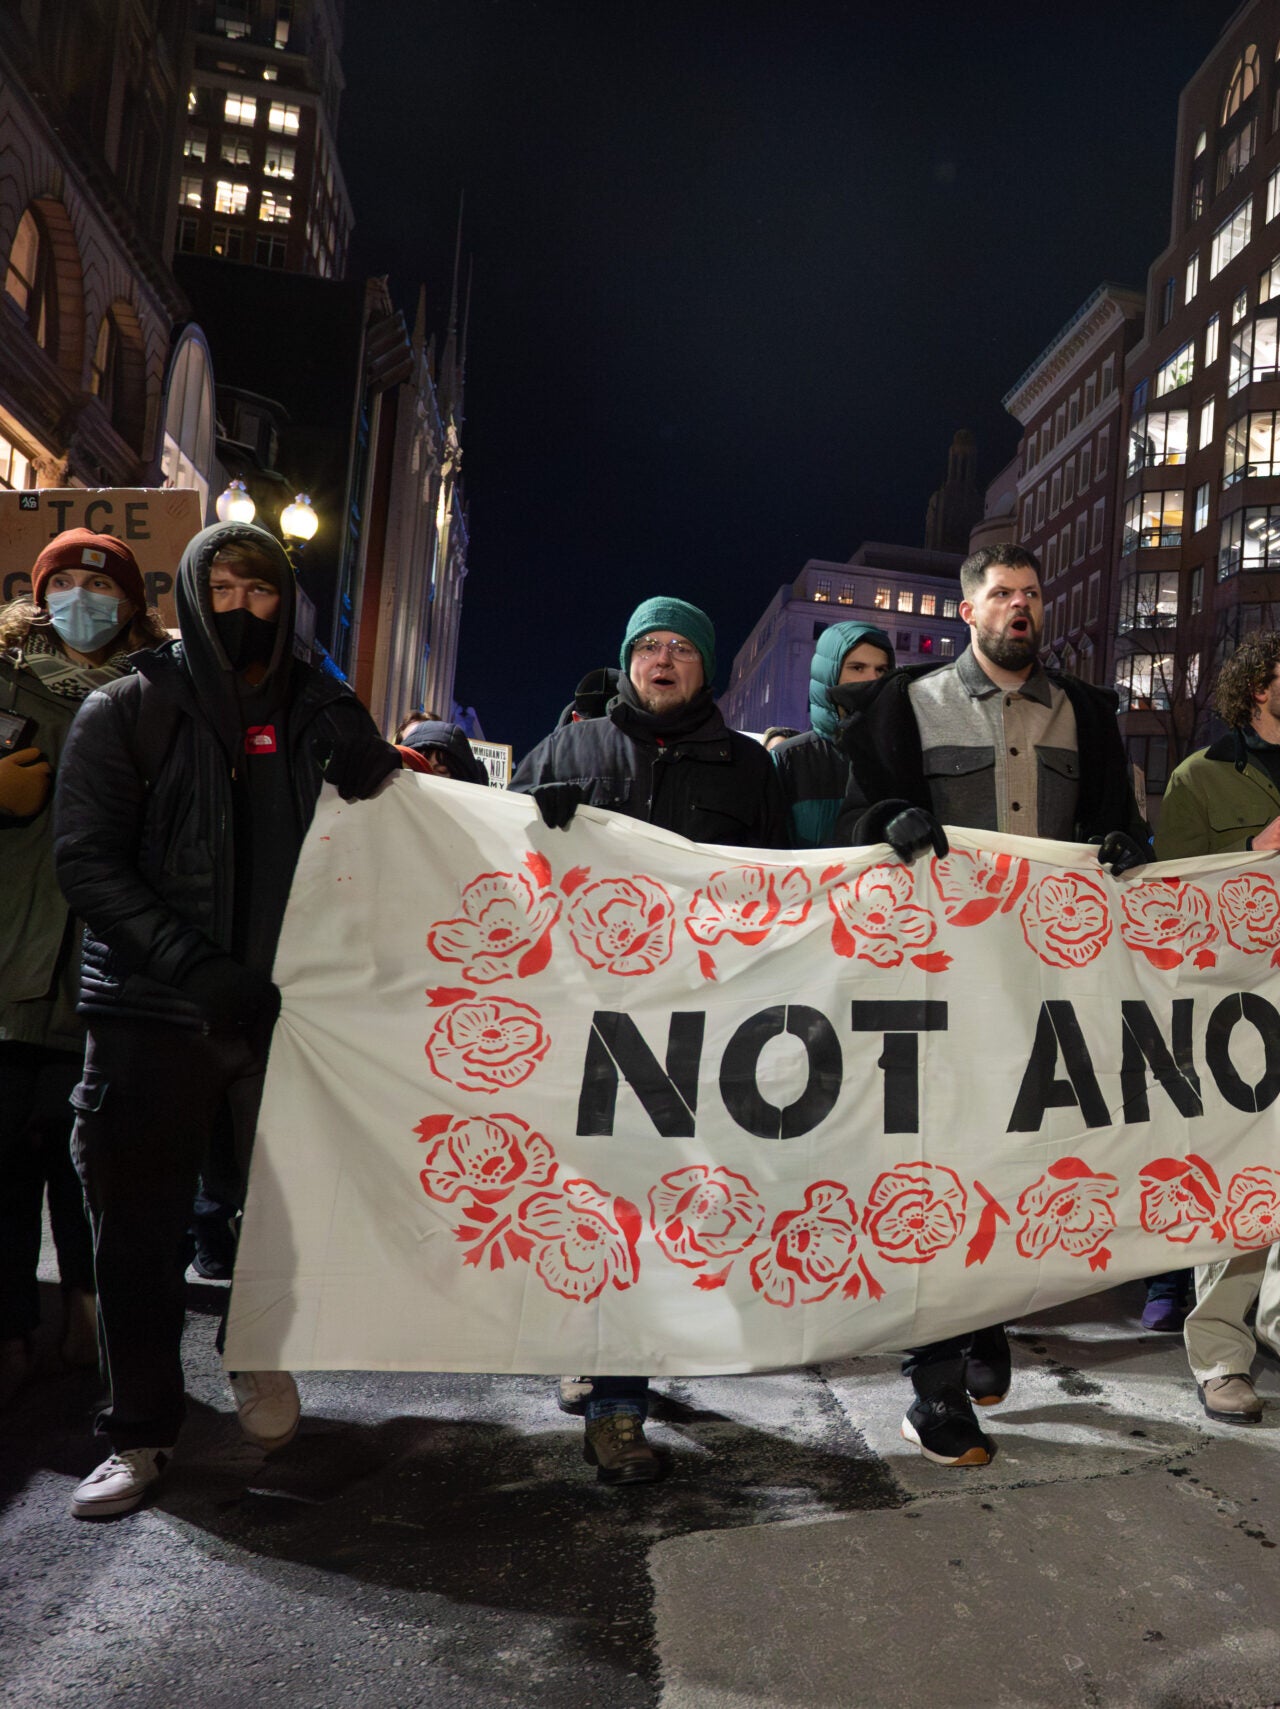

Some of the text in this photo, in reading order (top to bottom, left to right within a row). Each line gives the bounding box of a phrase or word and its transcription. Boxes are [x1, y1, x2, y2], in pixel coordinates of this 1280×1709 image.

[48, 500, 151, 540] ICE
[490, 759, 505, 779] NOT
[490, 781, 505, 790] MY
[576, 1000, 948, 1140] NOT
